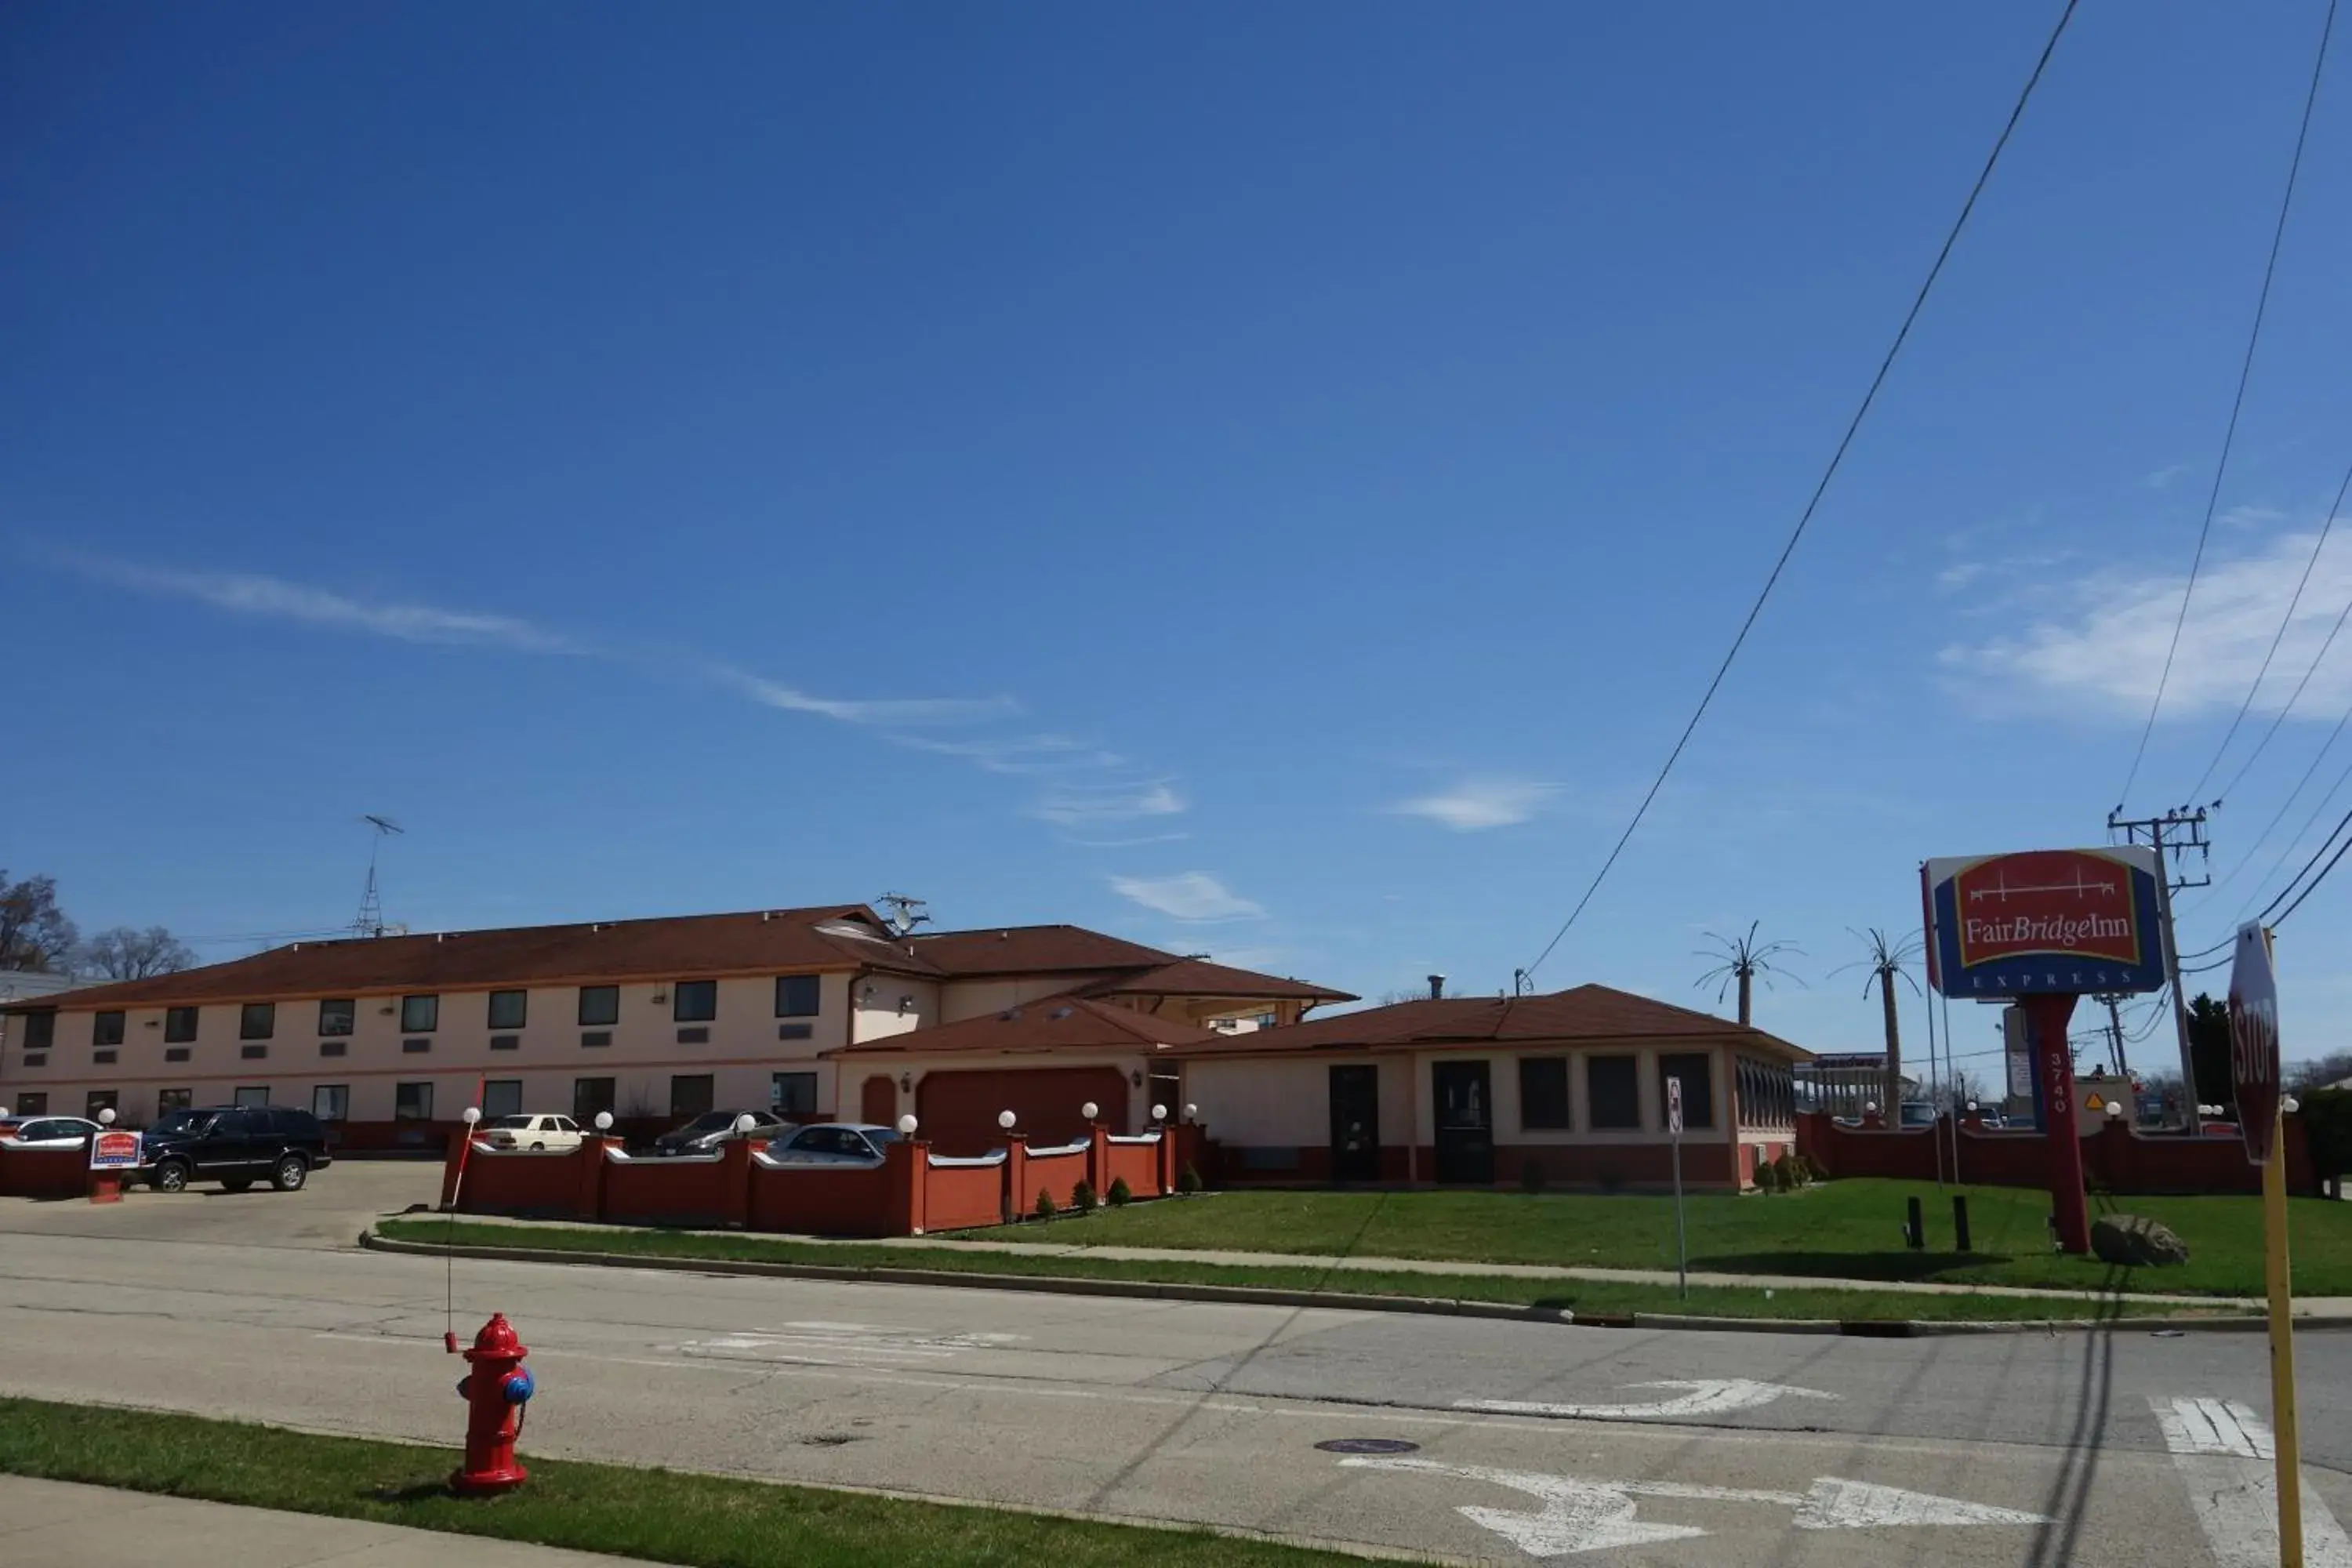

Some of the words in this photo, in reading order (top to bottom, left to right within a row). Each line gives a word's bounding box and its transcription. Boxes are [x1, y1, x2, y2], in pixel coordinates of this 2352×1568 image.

[1973, 971, 2131, 988] EXPRESS
[2235, 999, 2273, 1085] STOP
[2051, 1053, 2066, 1113] 3740
